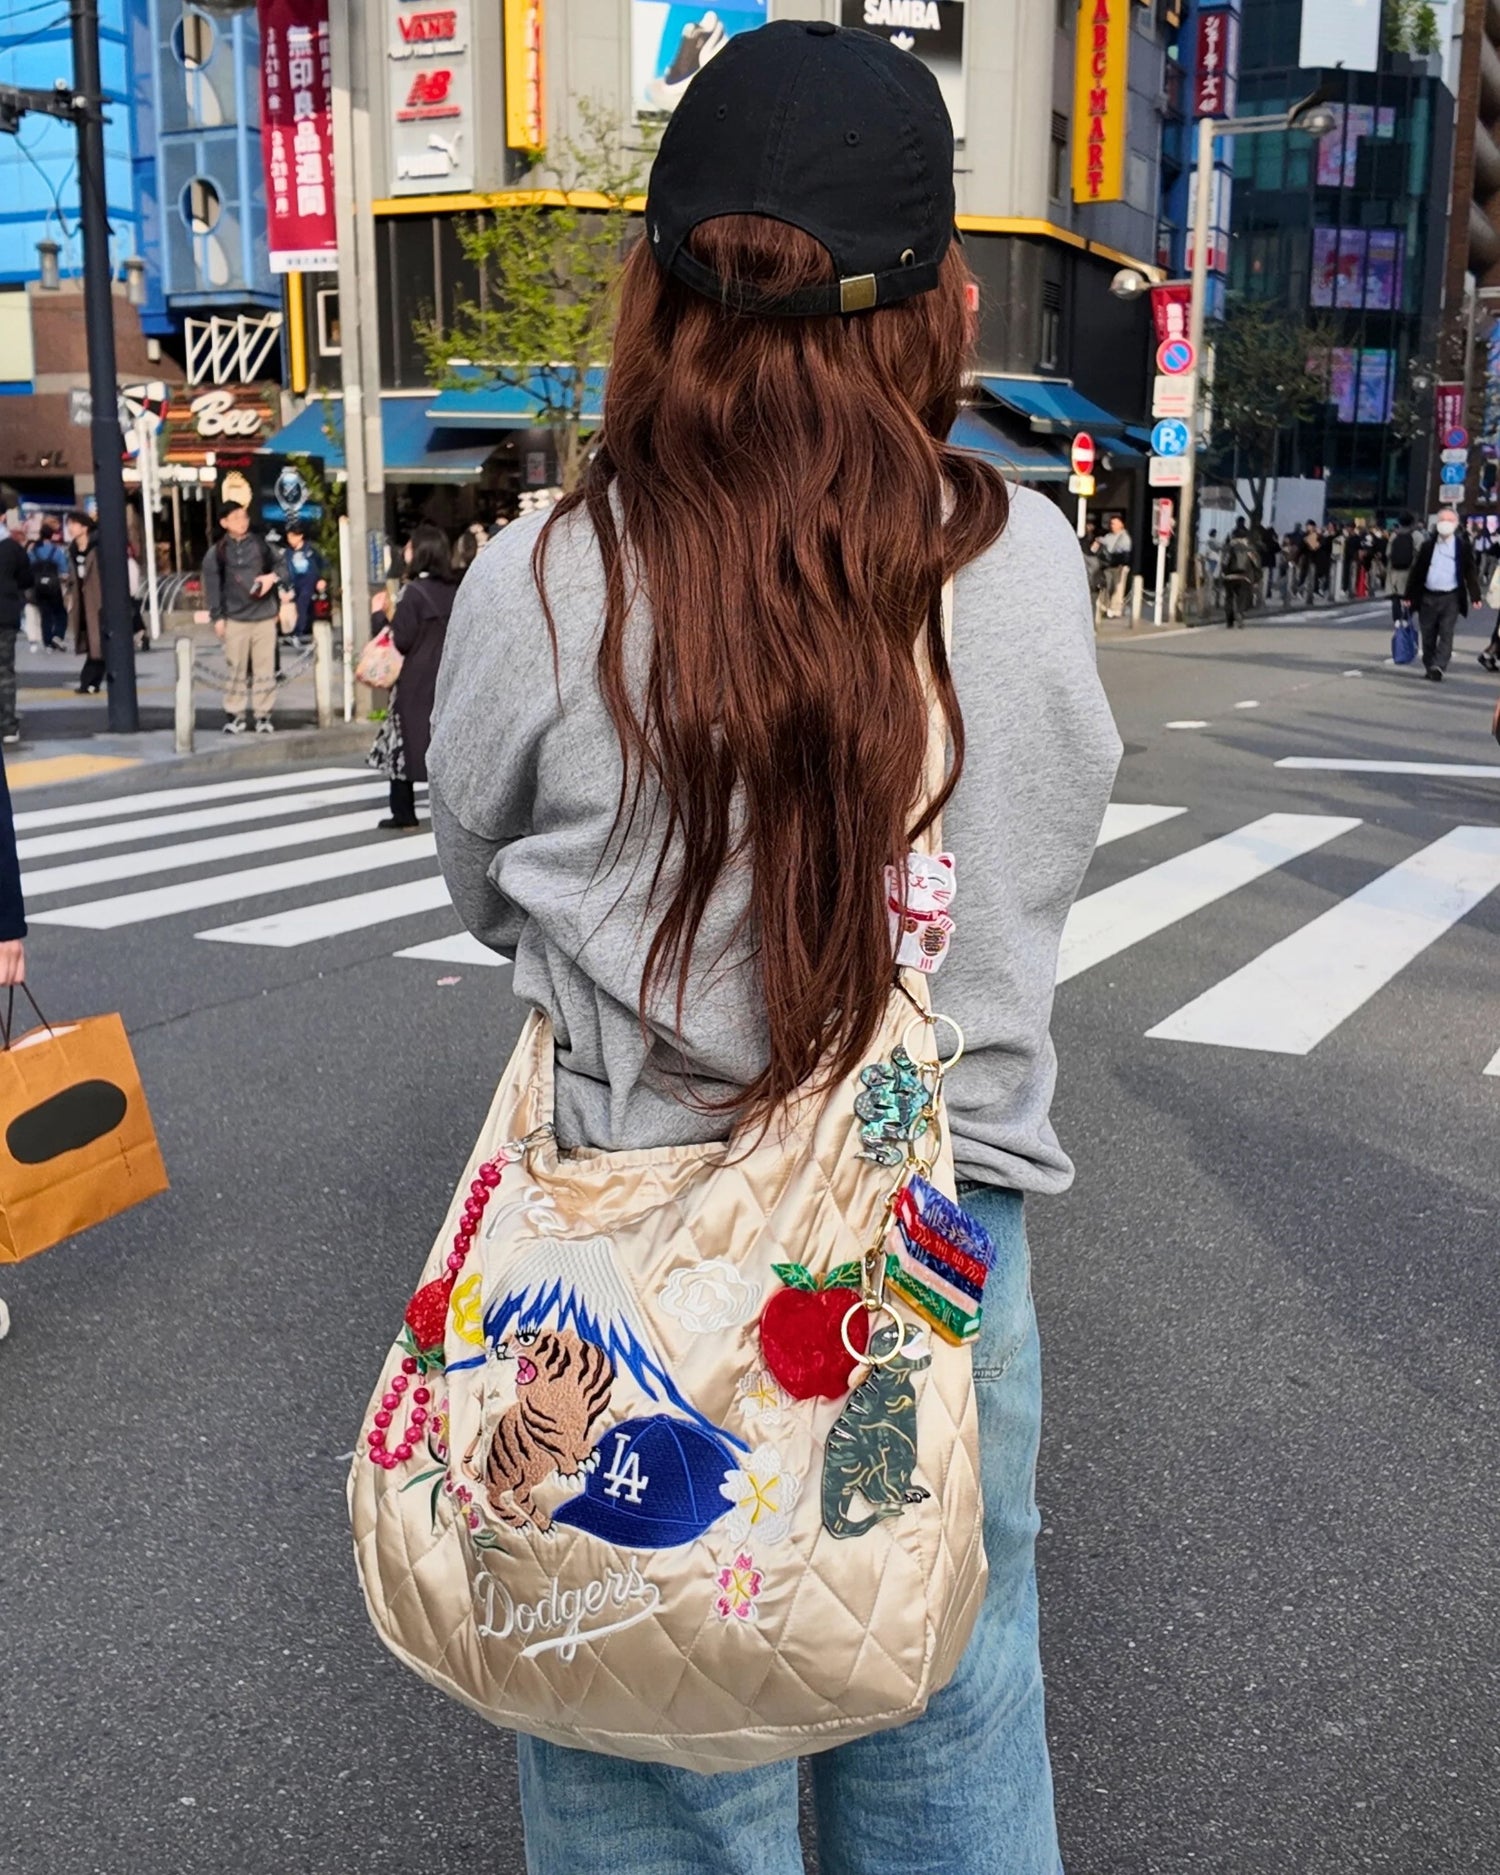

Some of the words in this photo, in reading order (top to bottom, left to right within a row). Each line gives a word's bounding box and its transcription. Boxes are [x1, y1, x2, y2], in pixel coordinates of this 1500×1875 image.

[398, 10, 457, 43] VANS
[863, 0, 941, 31] SAMBA
[190, 390, 263, 437] Bee
[603, 1432, 650, 1504] LA
[477, 1554, 661, 1663] Dodgers
